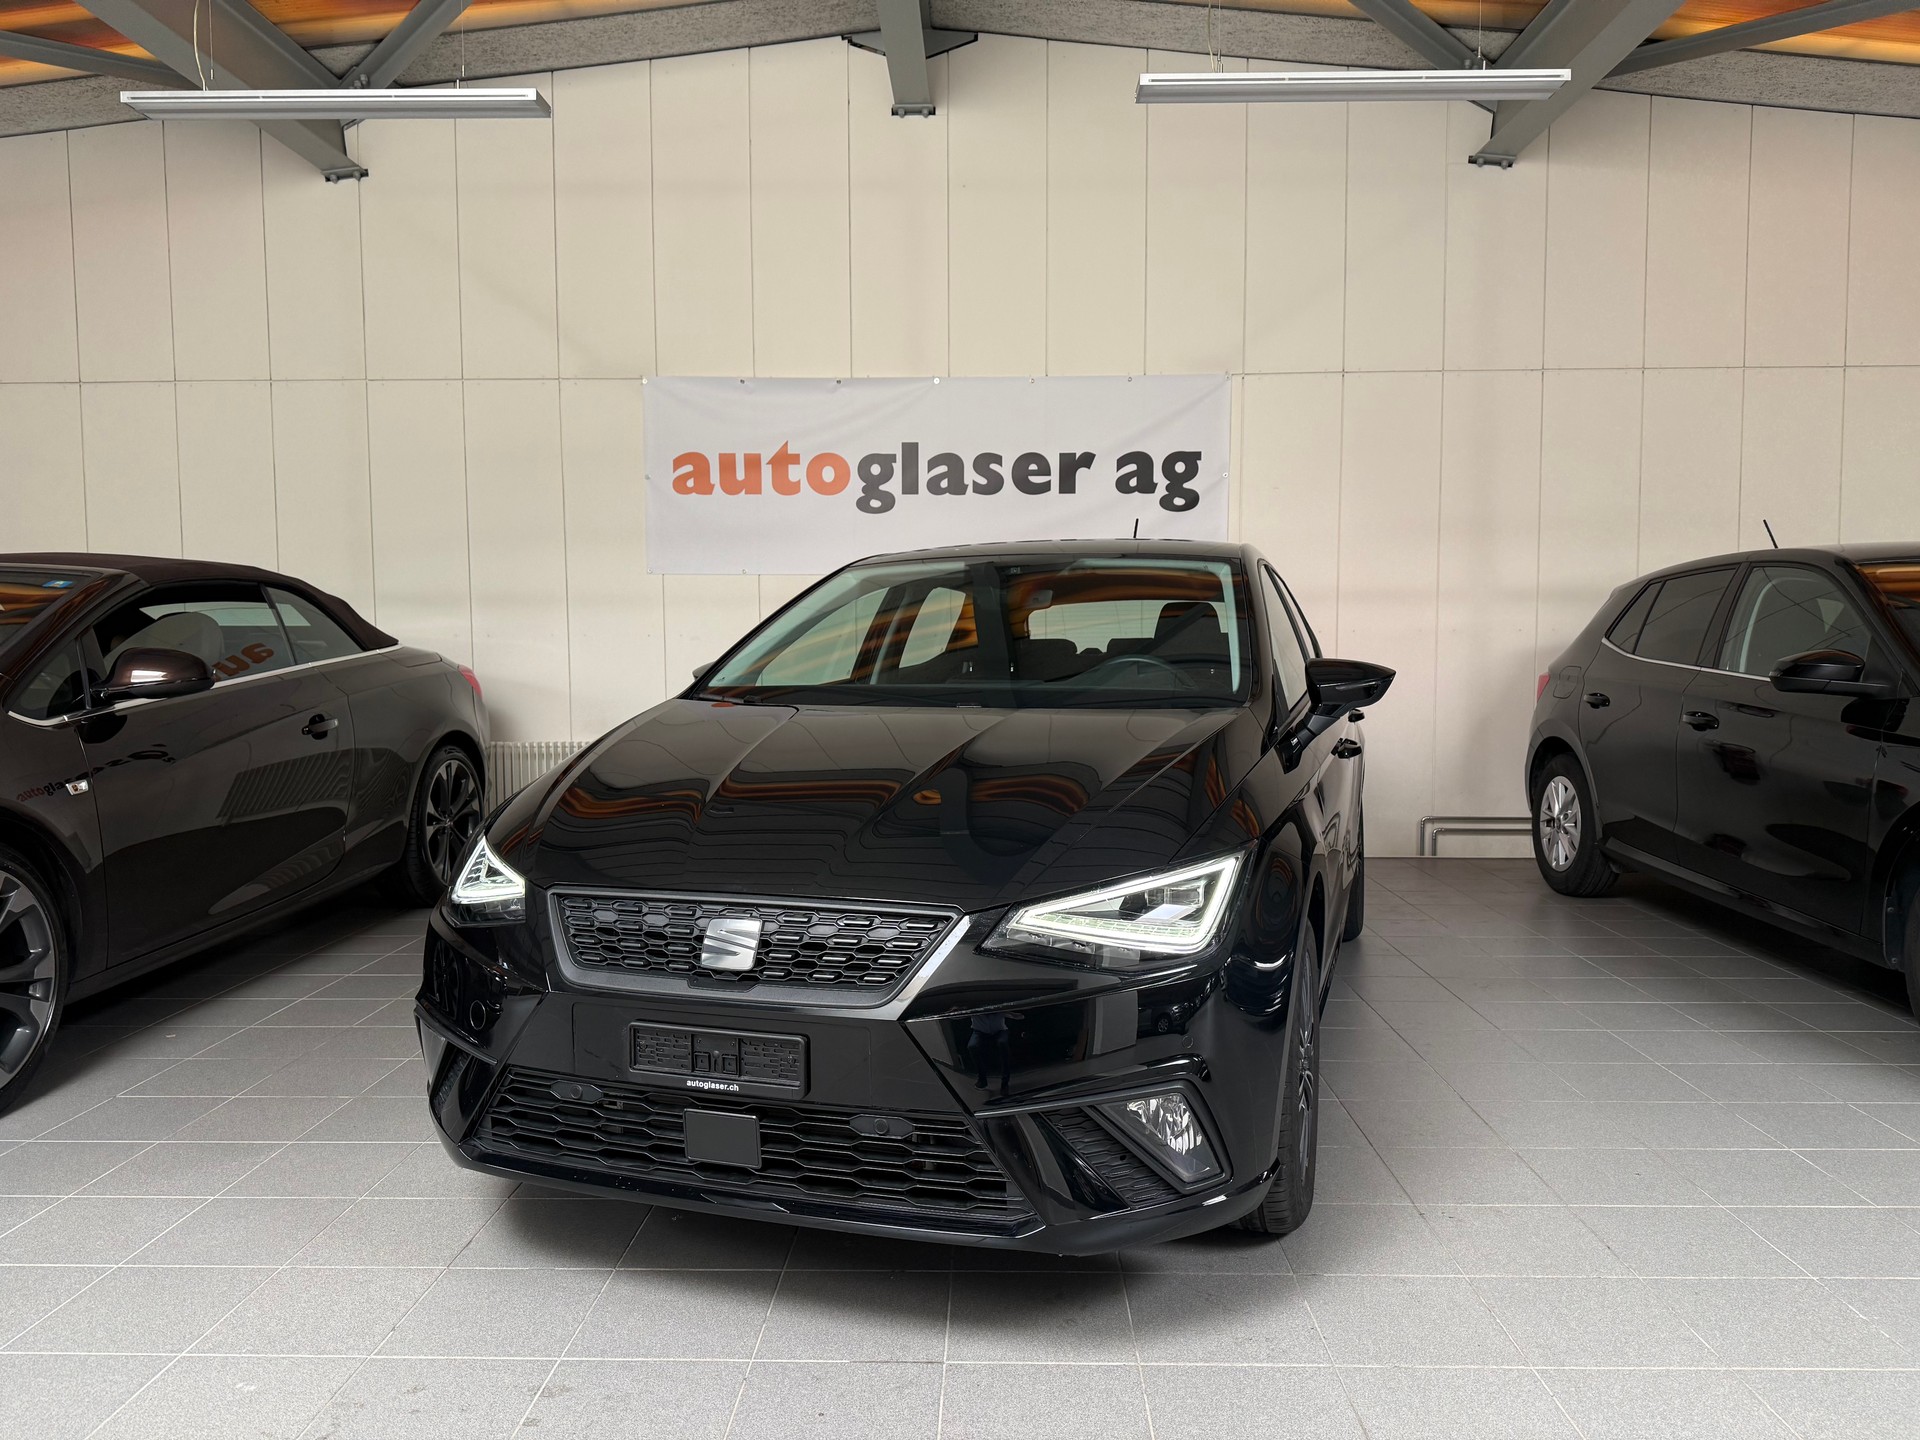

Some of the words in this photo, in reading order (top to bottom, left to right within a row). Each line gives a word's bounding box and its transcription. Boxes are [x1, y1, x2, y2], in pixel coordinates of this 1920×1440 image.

[672, 440, 1097, 515] autoglaser
[1114, 450, 1202, 513] ag
[686, 1080, 739, 1092] autoglaser.ch
